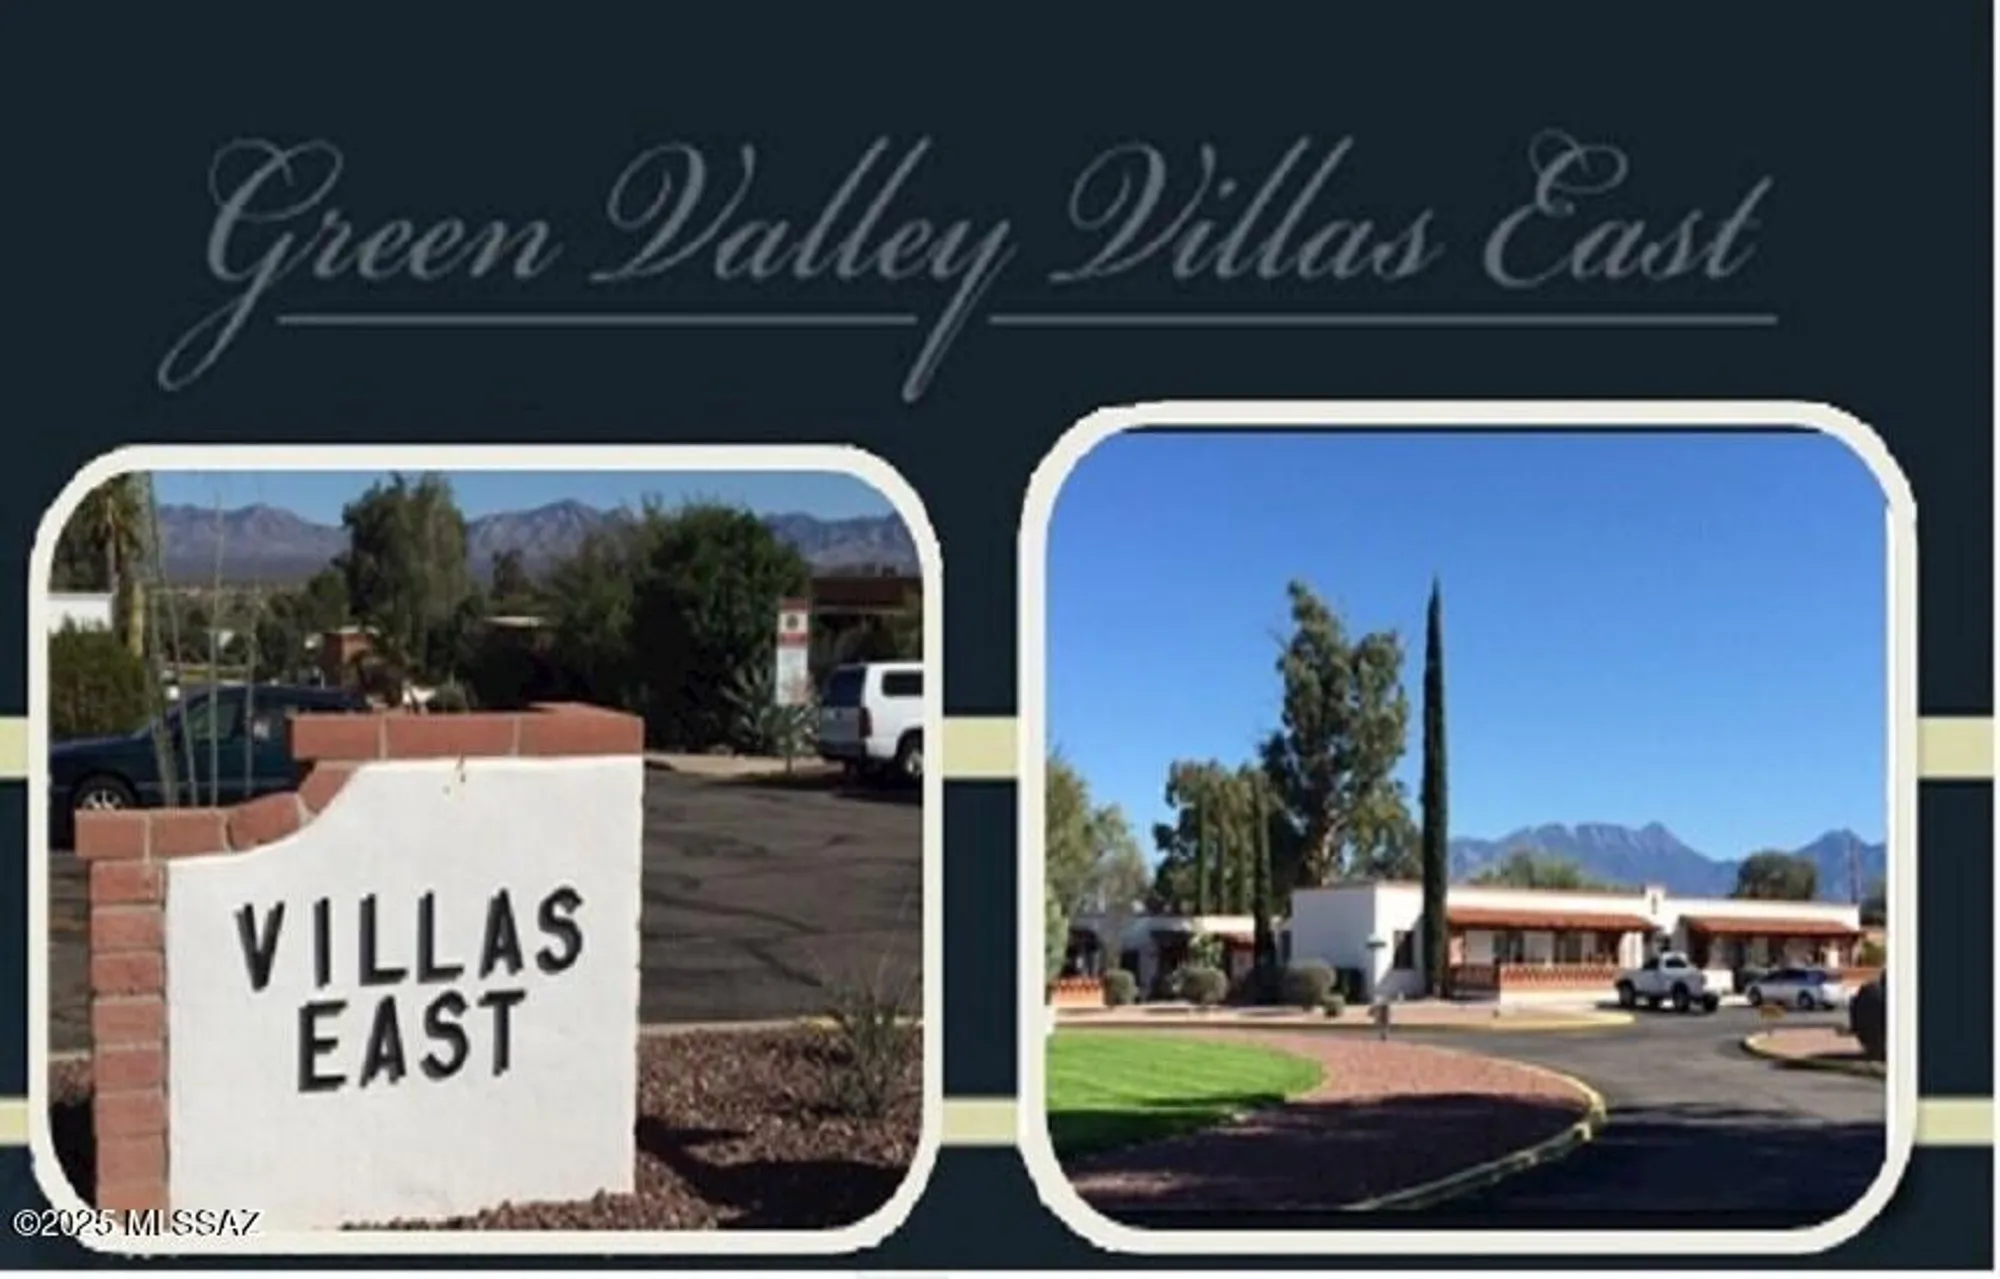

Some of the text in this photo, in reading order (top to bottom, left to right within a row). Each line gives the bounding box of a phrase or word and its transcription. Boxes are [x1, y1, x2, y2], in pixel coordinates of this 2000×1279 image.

[158, 128, 1772, 404] Green Valley Villas East
[235, 885, 584, 993] VILLAS
[298, 989, 527, 1093] EAST
